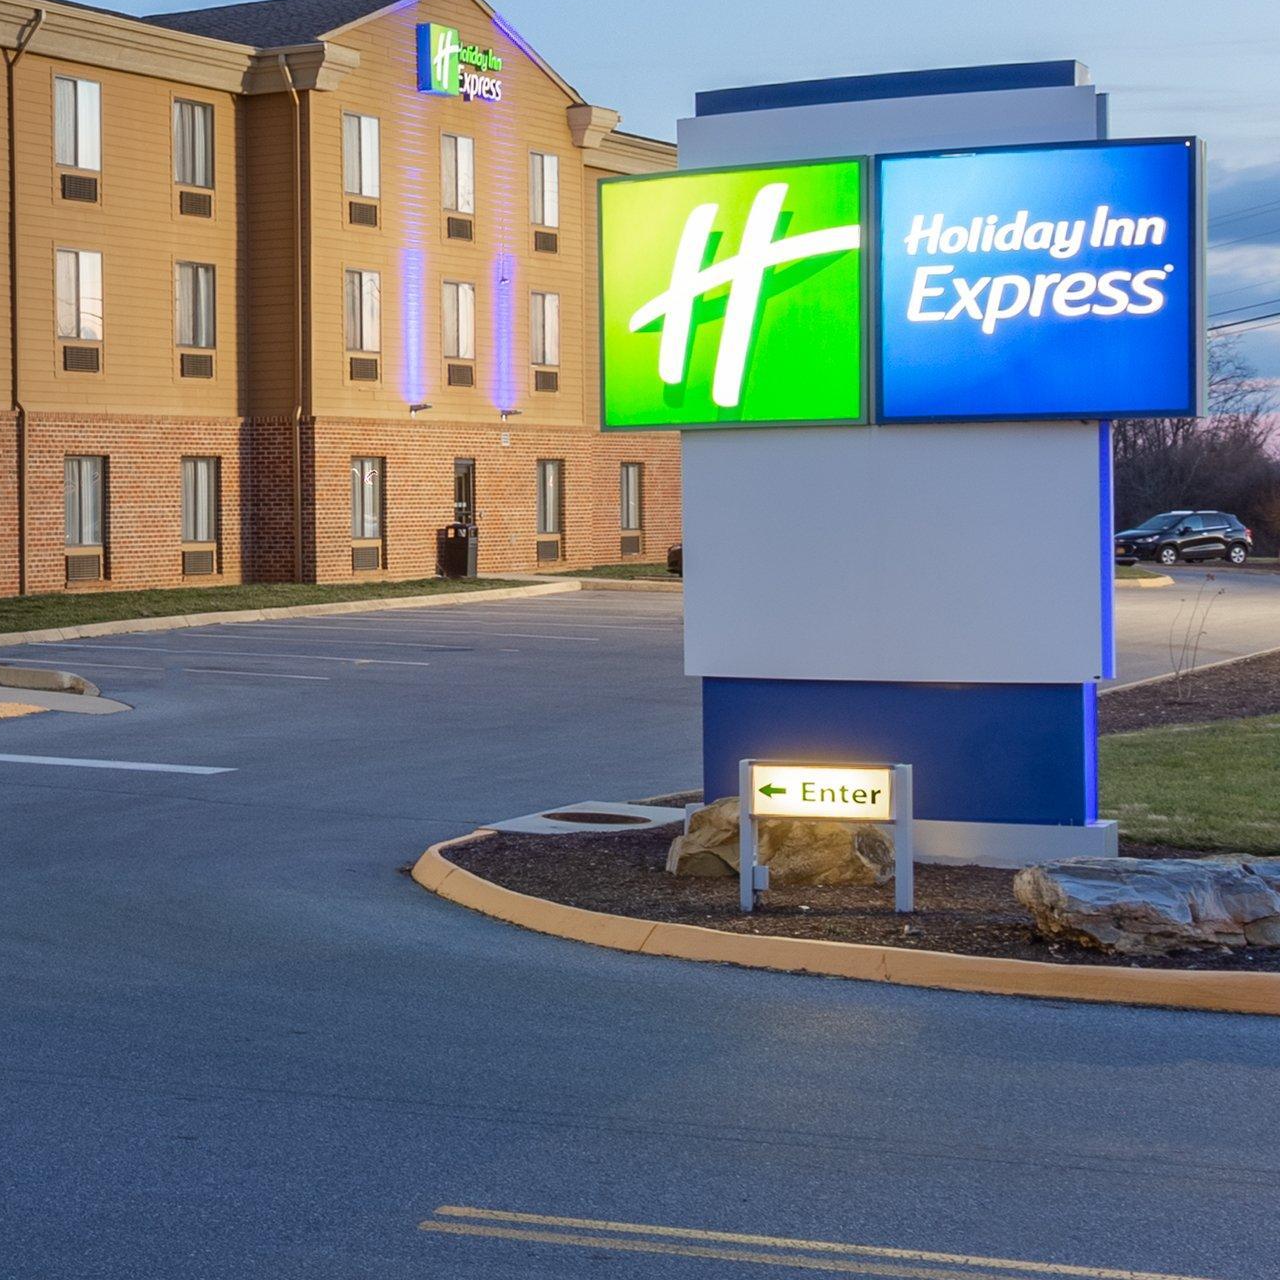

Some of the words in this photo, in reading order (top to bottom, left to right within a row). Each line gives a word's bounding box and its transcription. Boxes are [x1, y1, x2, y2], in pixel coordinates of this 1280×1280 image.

[488, 49, 502, 70] Inn
[458, 64, 502, 101] Express
[904, 209, 1086, 260] Holiday
[1092, 205, 1166, 248] Inn
[906, 264, 1168, 335] Express
[801, 782, 881, 805] Enter
